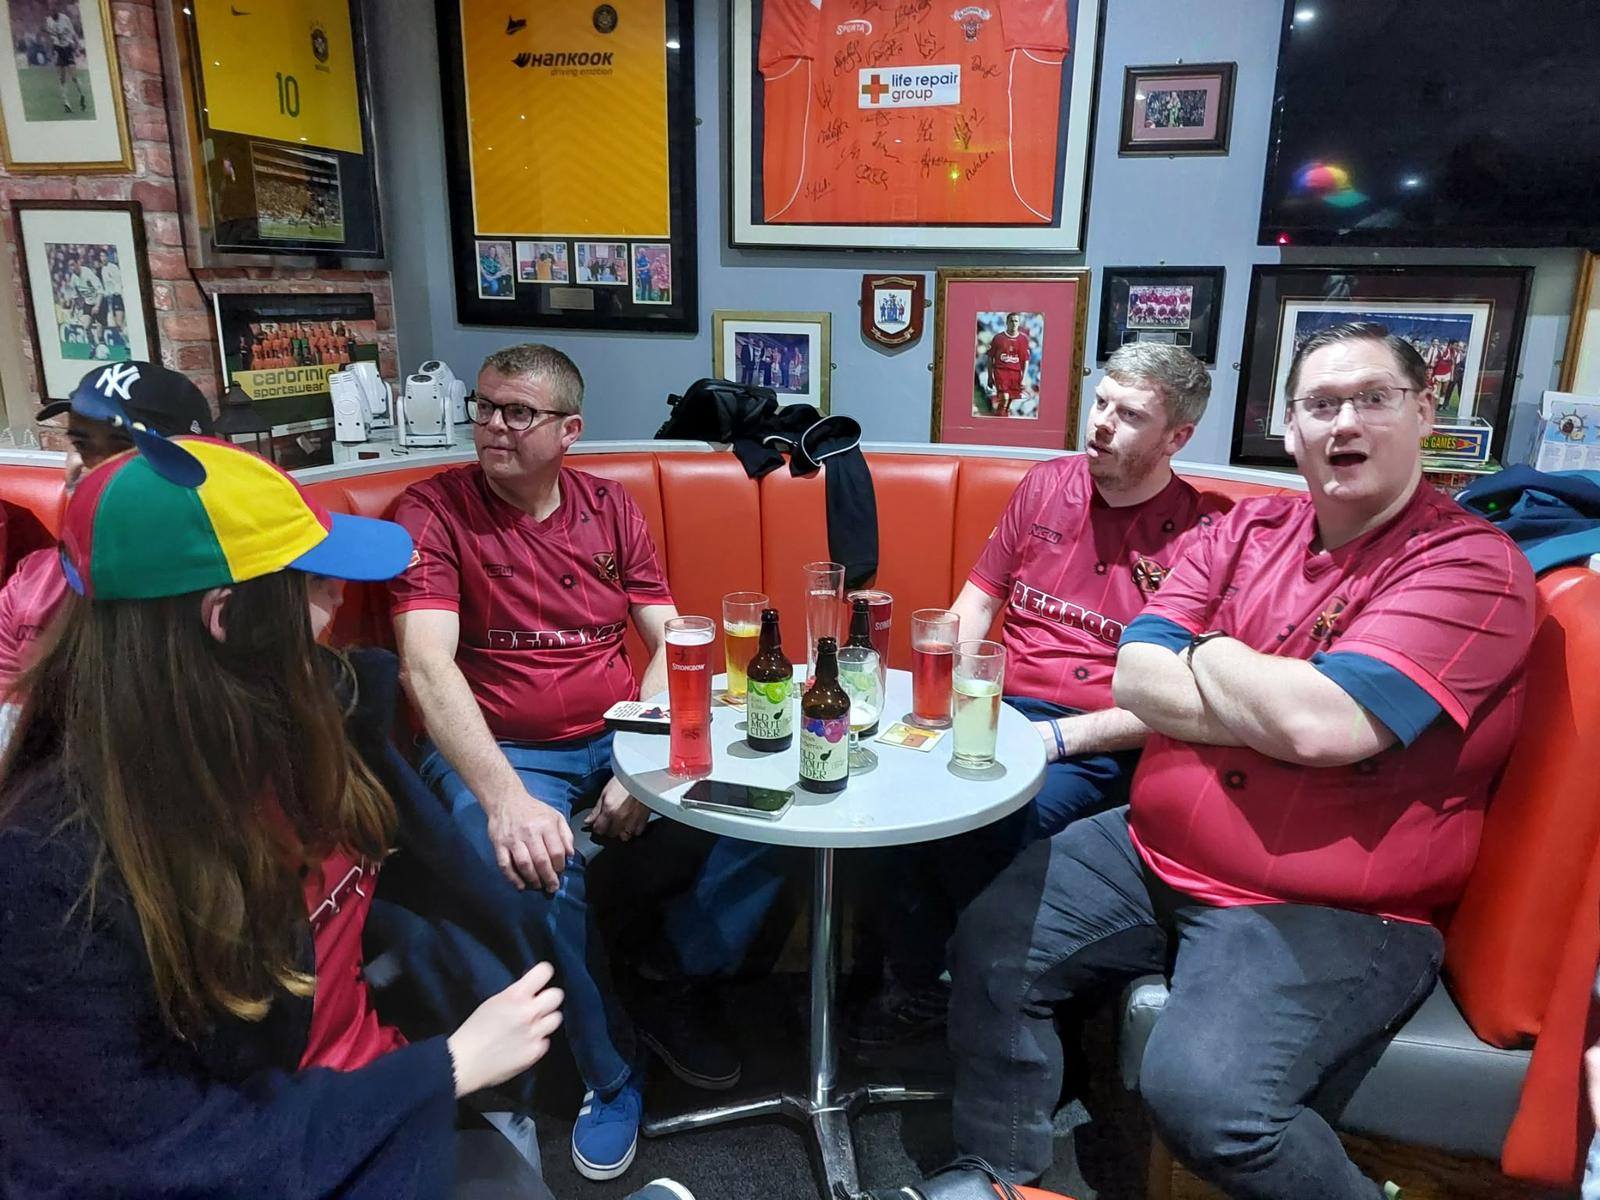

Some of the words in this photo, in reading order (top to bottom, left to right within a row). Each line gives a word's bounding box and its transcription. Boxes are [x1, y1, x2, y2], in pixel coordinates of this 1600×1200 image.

[891, 74, 912, 87] life
[915, 71, 958, 88] repair
[276, 71, 300, 118] 10
[892, 88, 934, 103] group
[252, 367, 324, 387] carbrini
[253, 383, 325, 399] sportswear
[1430, 436, 1456, 450] GAMES
[1010, 580, 1128, 645] REDROO
[750, 711, 769, 721] OLD
[750, 719, 781, 729] MOUT
[750, 727, 781, 738] CIDER
